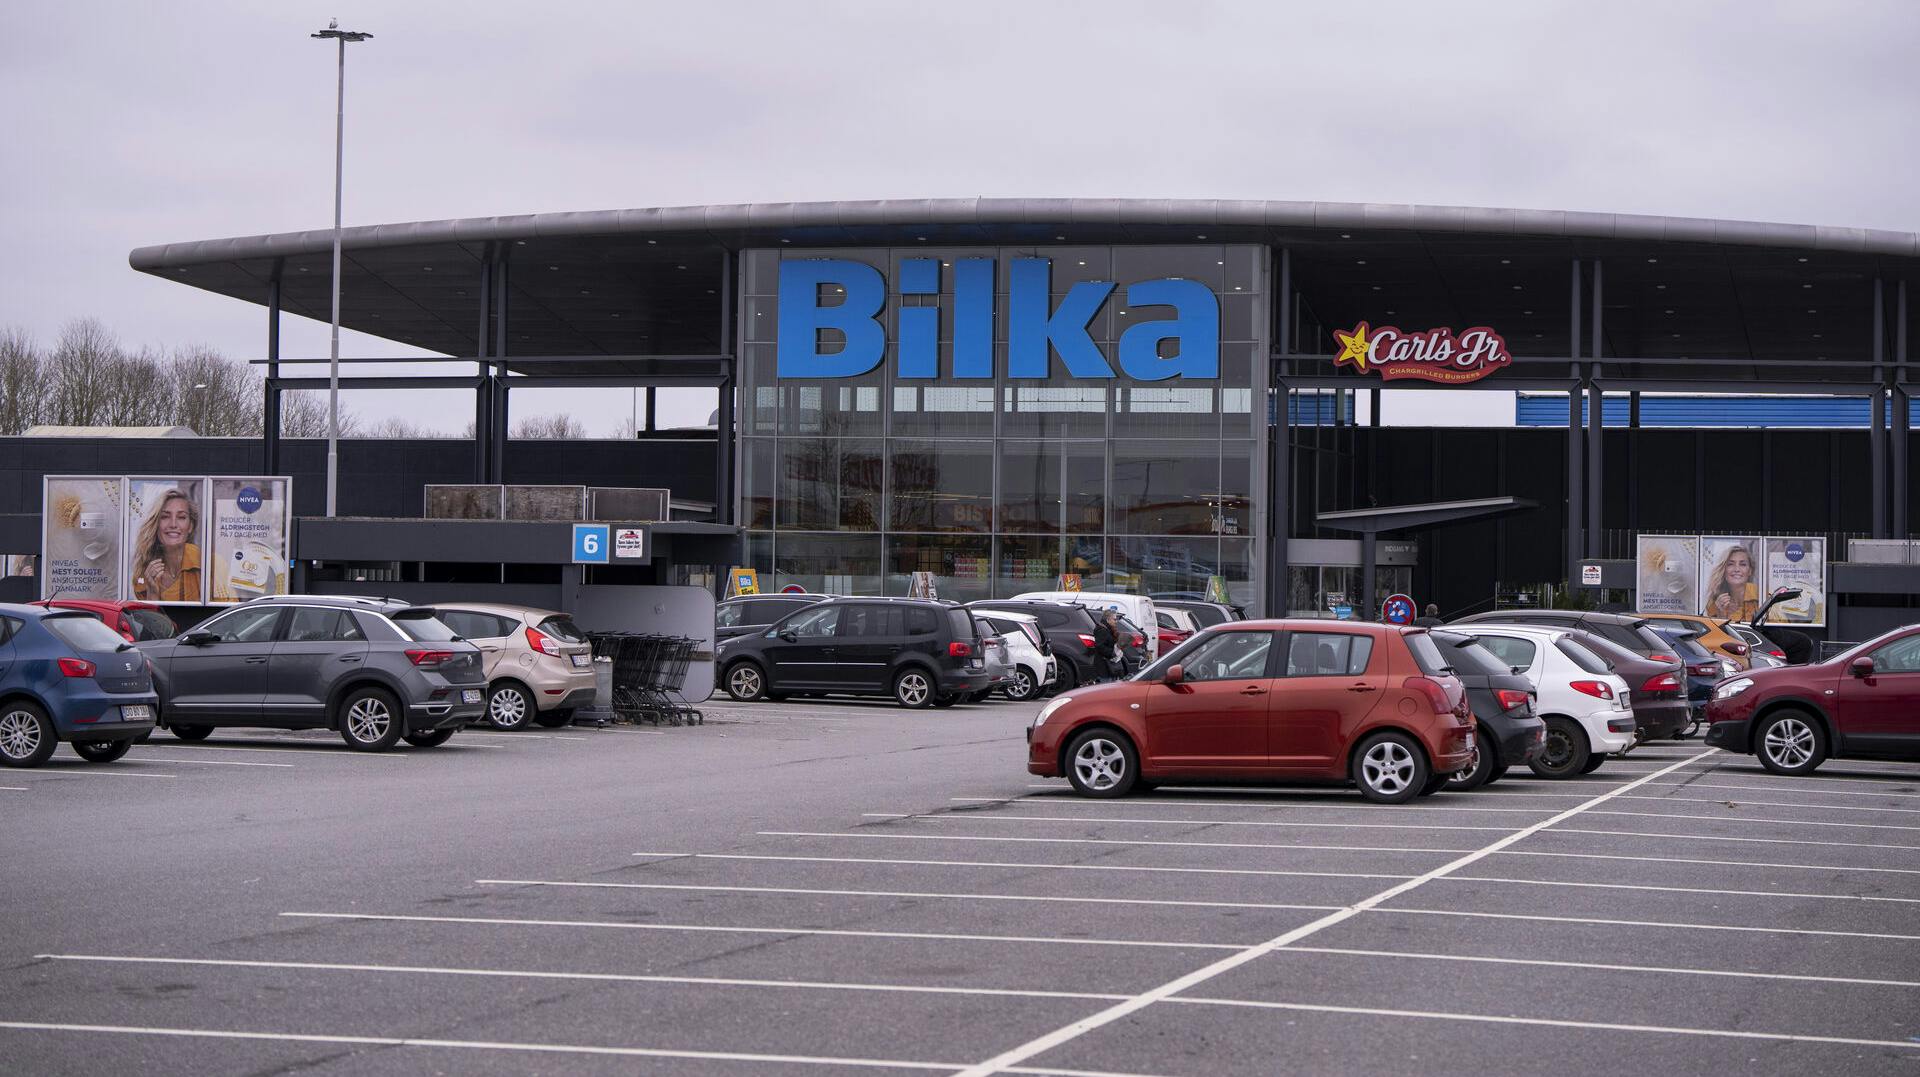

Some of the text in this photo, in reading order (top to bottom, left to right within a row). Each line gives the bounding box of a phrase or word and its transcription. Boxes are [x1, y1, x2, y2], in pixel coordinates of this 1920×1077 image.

[777, 257, 1220, 381] Bilka
[1367, 330, 1506, 366] Carl's Jr.
[1389, 367, 1481, 380] CHARGRILLED BURGERS
[220, 516, 252, 524] REDUCER
[583, 534, 599, 554] 6
[51, 559, 79, 567] NIVEAS
[51, 568, 72, 576] MEST
